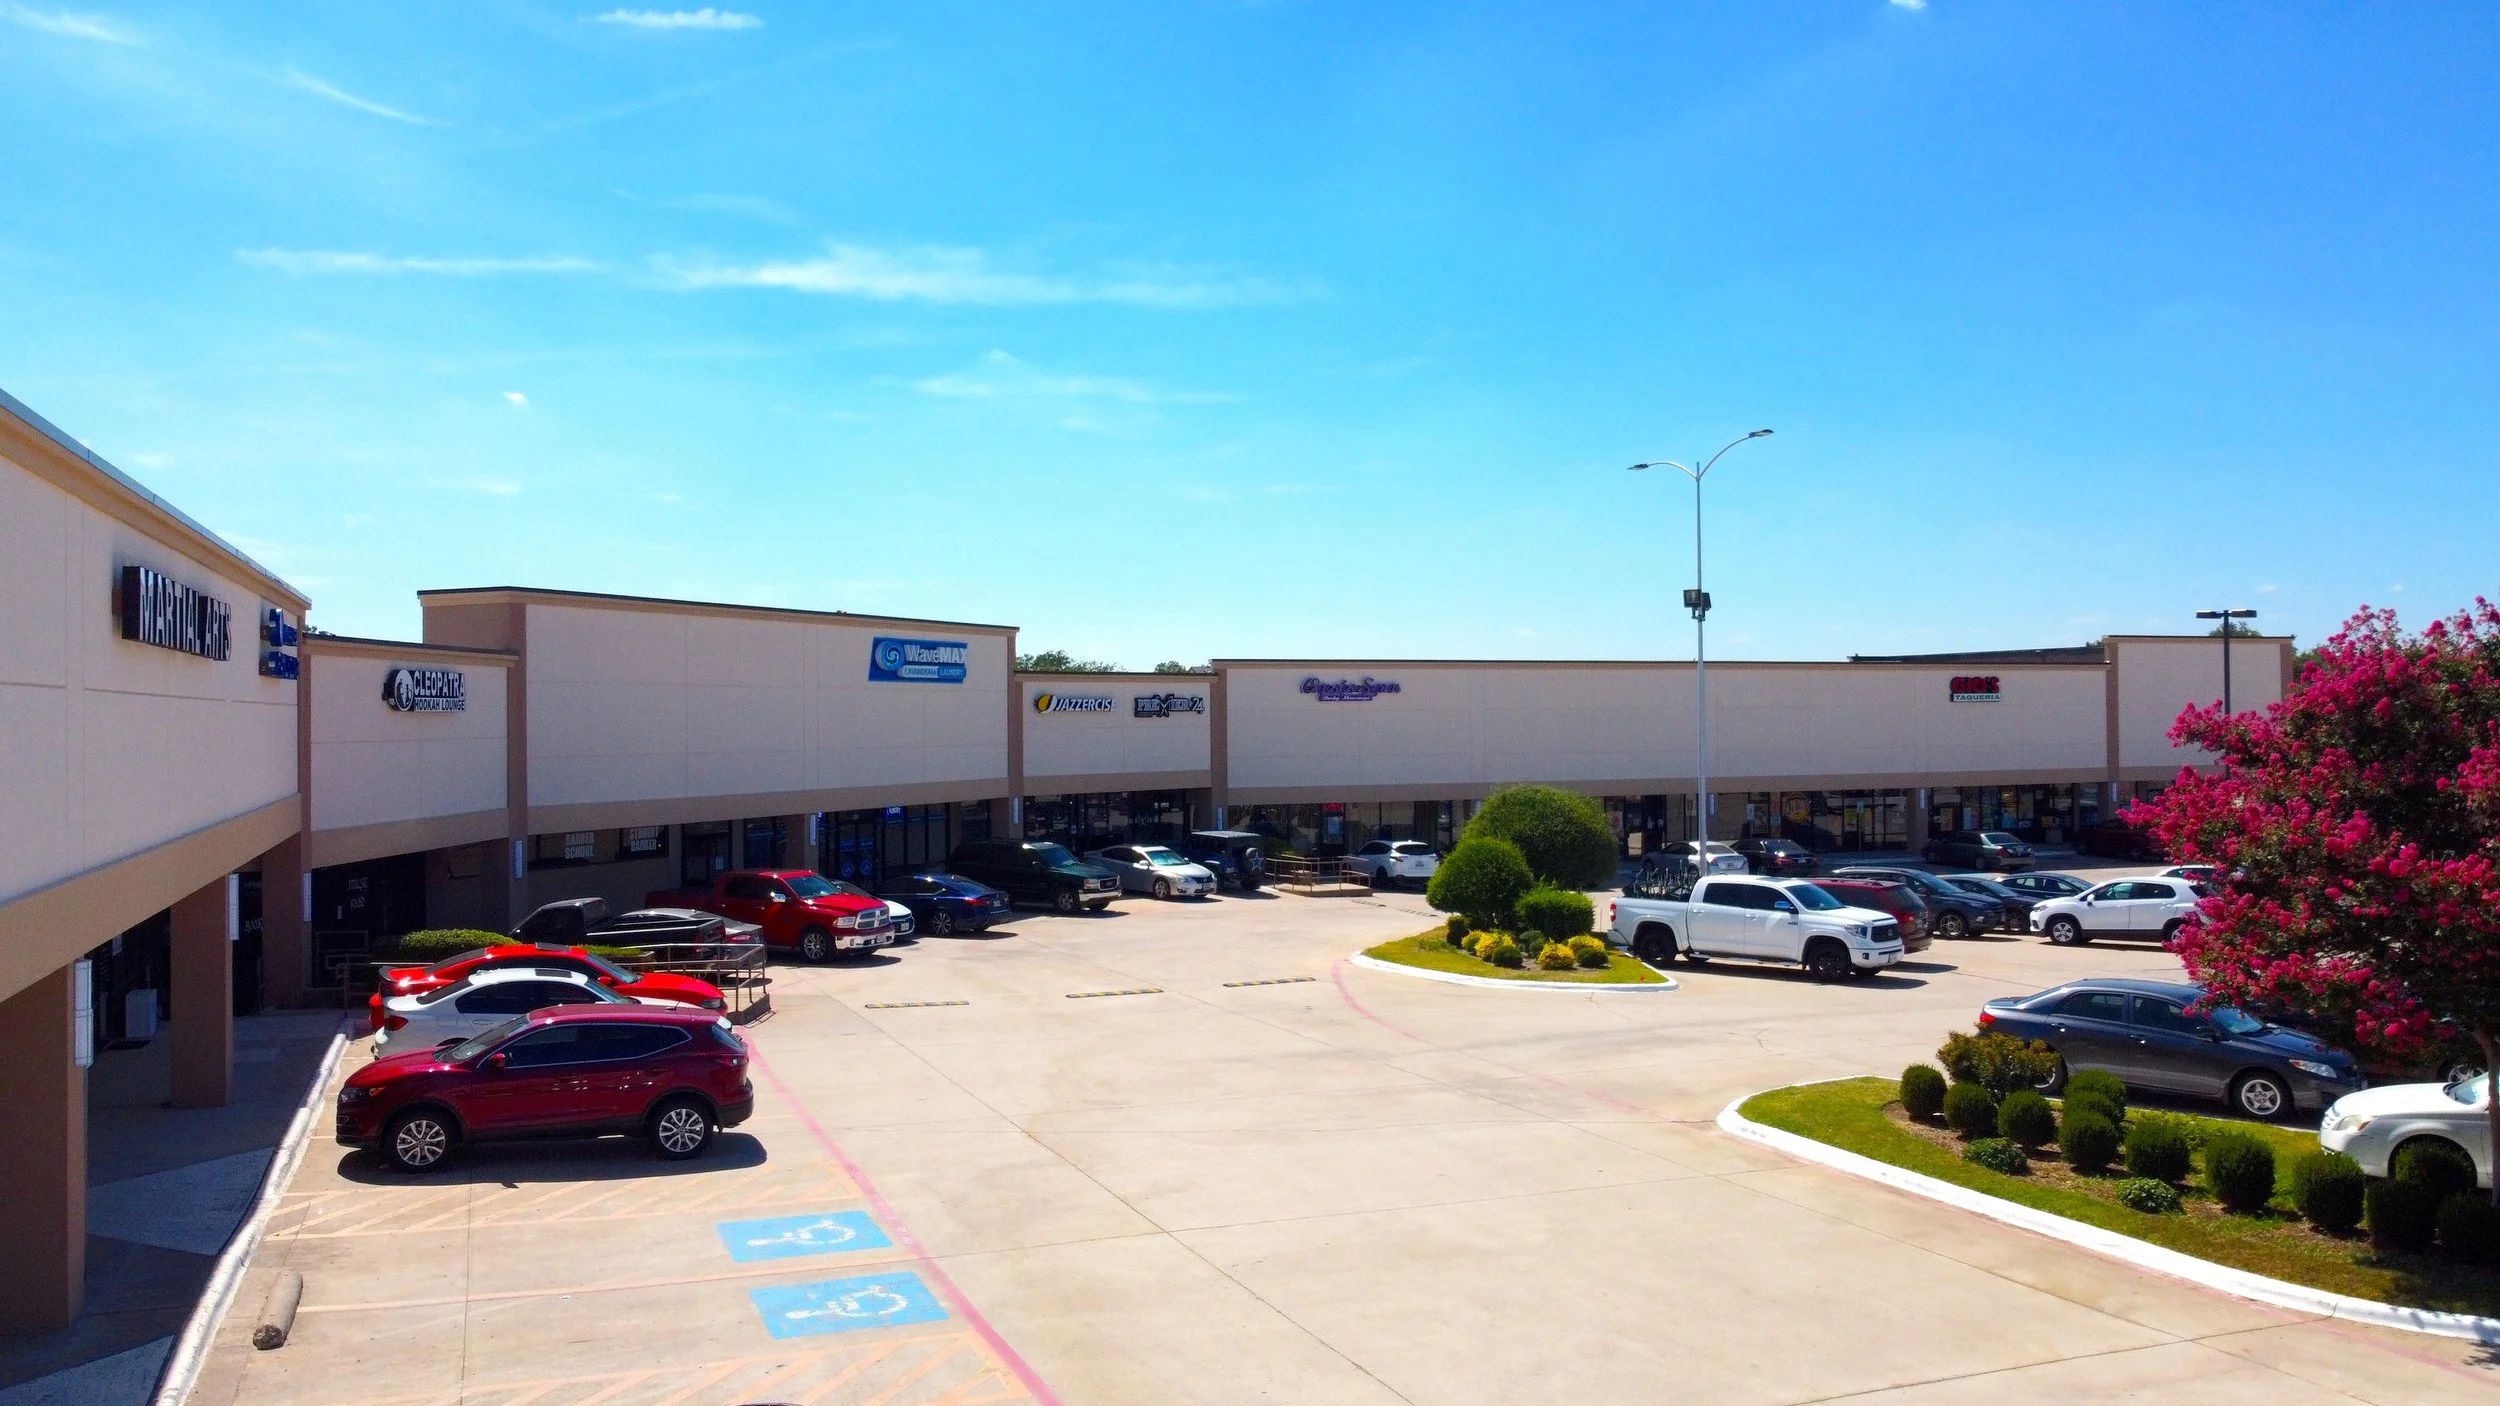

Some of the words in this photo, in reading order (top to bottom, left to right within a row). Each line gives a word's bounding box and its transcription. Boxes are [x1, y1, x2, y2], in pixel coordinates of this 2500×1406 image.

[139, 566, 201, 656] MARTIAL
[204, 596, 232, 662] ARTS
[903, 644, 967, 664] WaveMAX
[413, 670, 466, 697] CLEOPATRA
[414, 698, 440, 711] HOOKAH
[1055, 698, 1116, 711] JAZZERCISE
